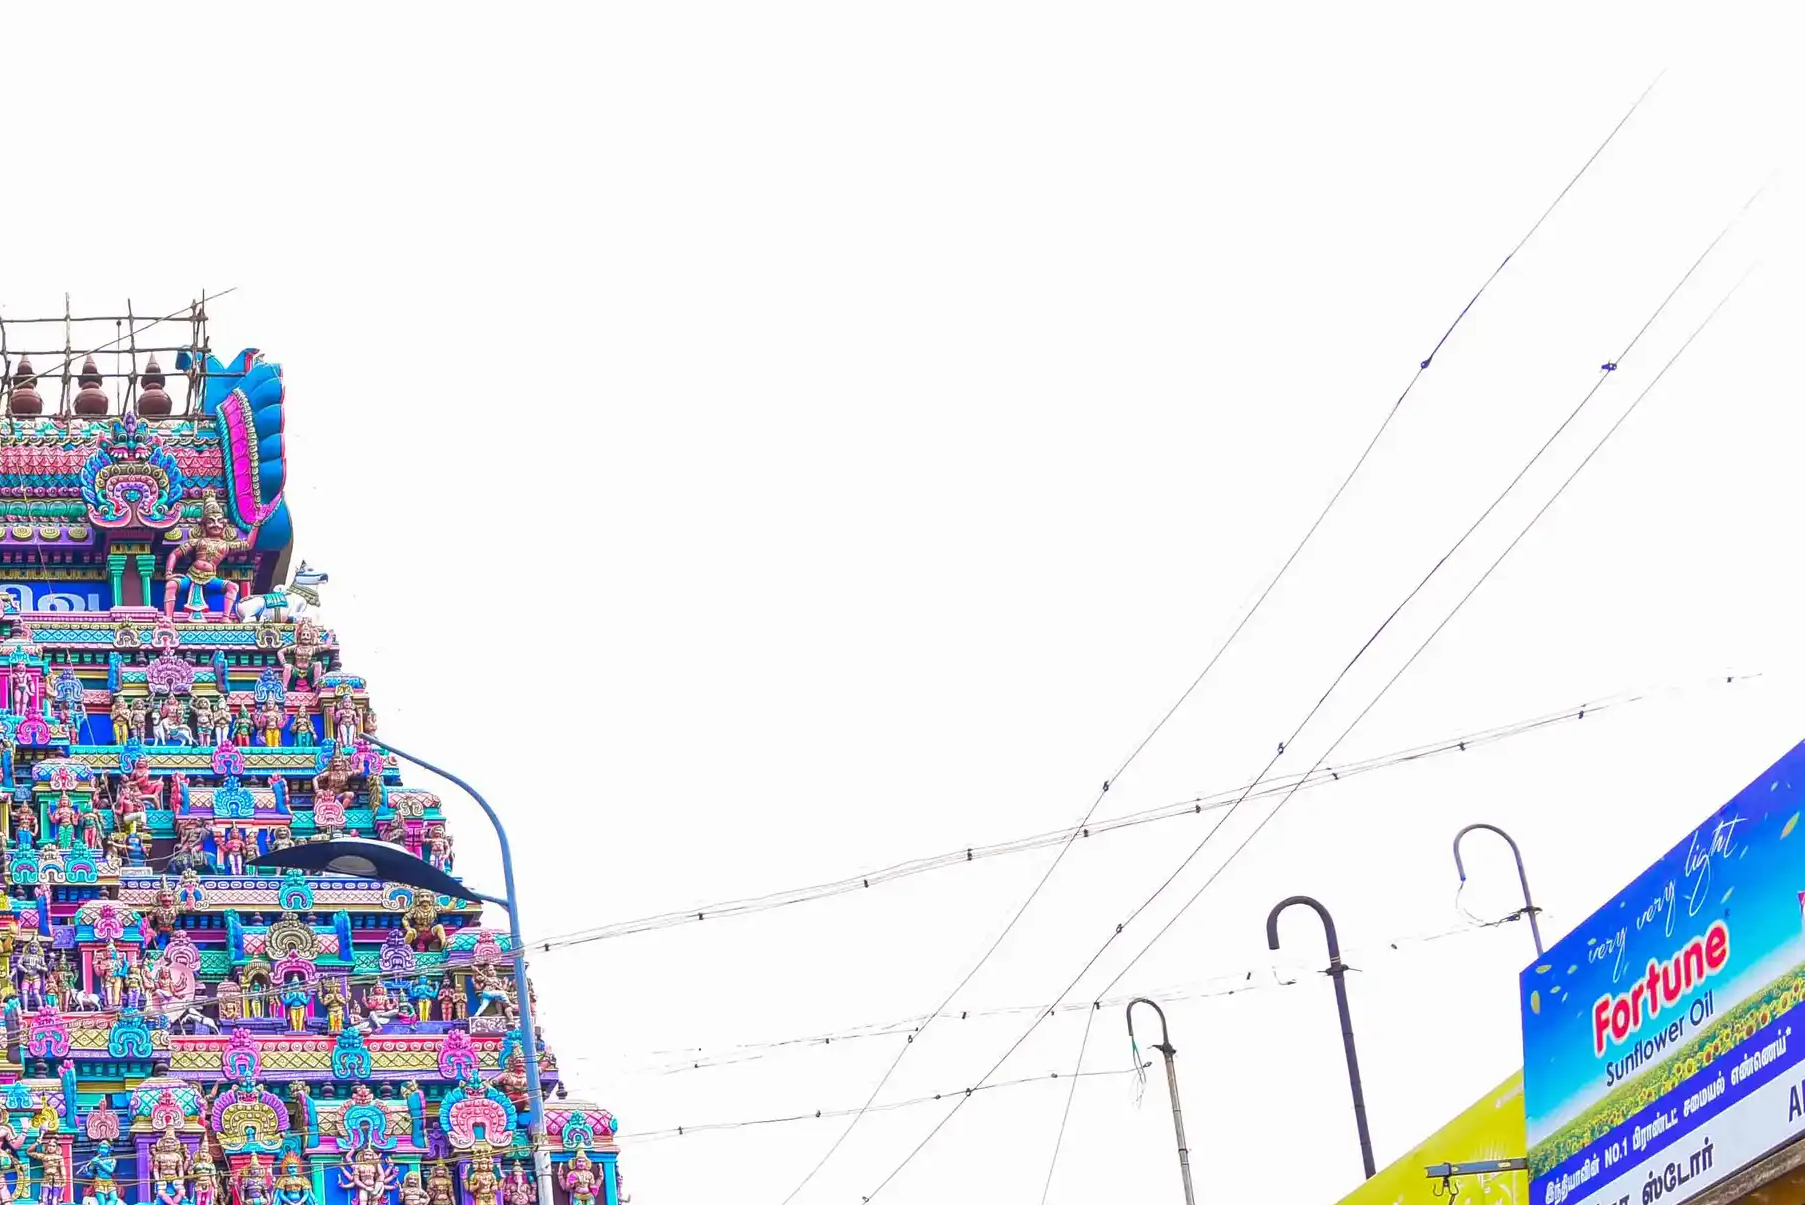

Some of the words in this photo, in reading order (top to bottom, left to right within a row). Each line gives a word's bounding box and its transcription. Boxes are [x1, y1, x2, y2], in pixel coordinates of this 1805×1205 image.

[1589, 927, 1627, 983] very
[1637, 880, 1675, 937] very
[1685, 815, 1747, 916] light
[1594, 920, 1729, 1058] Fortune
[1606, 1015, 1684, 1087] Sunflower
[1690, 989, 1714, 1023] Oil
[1546, 1153, 1600, 1205] இந்தியாவின்
[1604, 1140, 1628, 1169] NO.1
[1683, 1072, 1725, 1117] சமையல்
